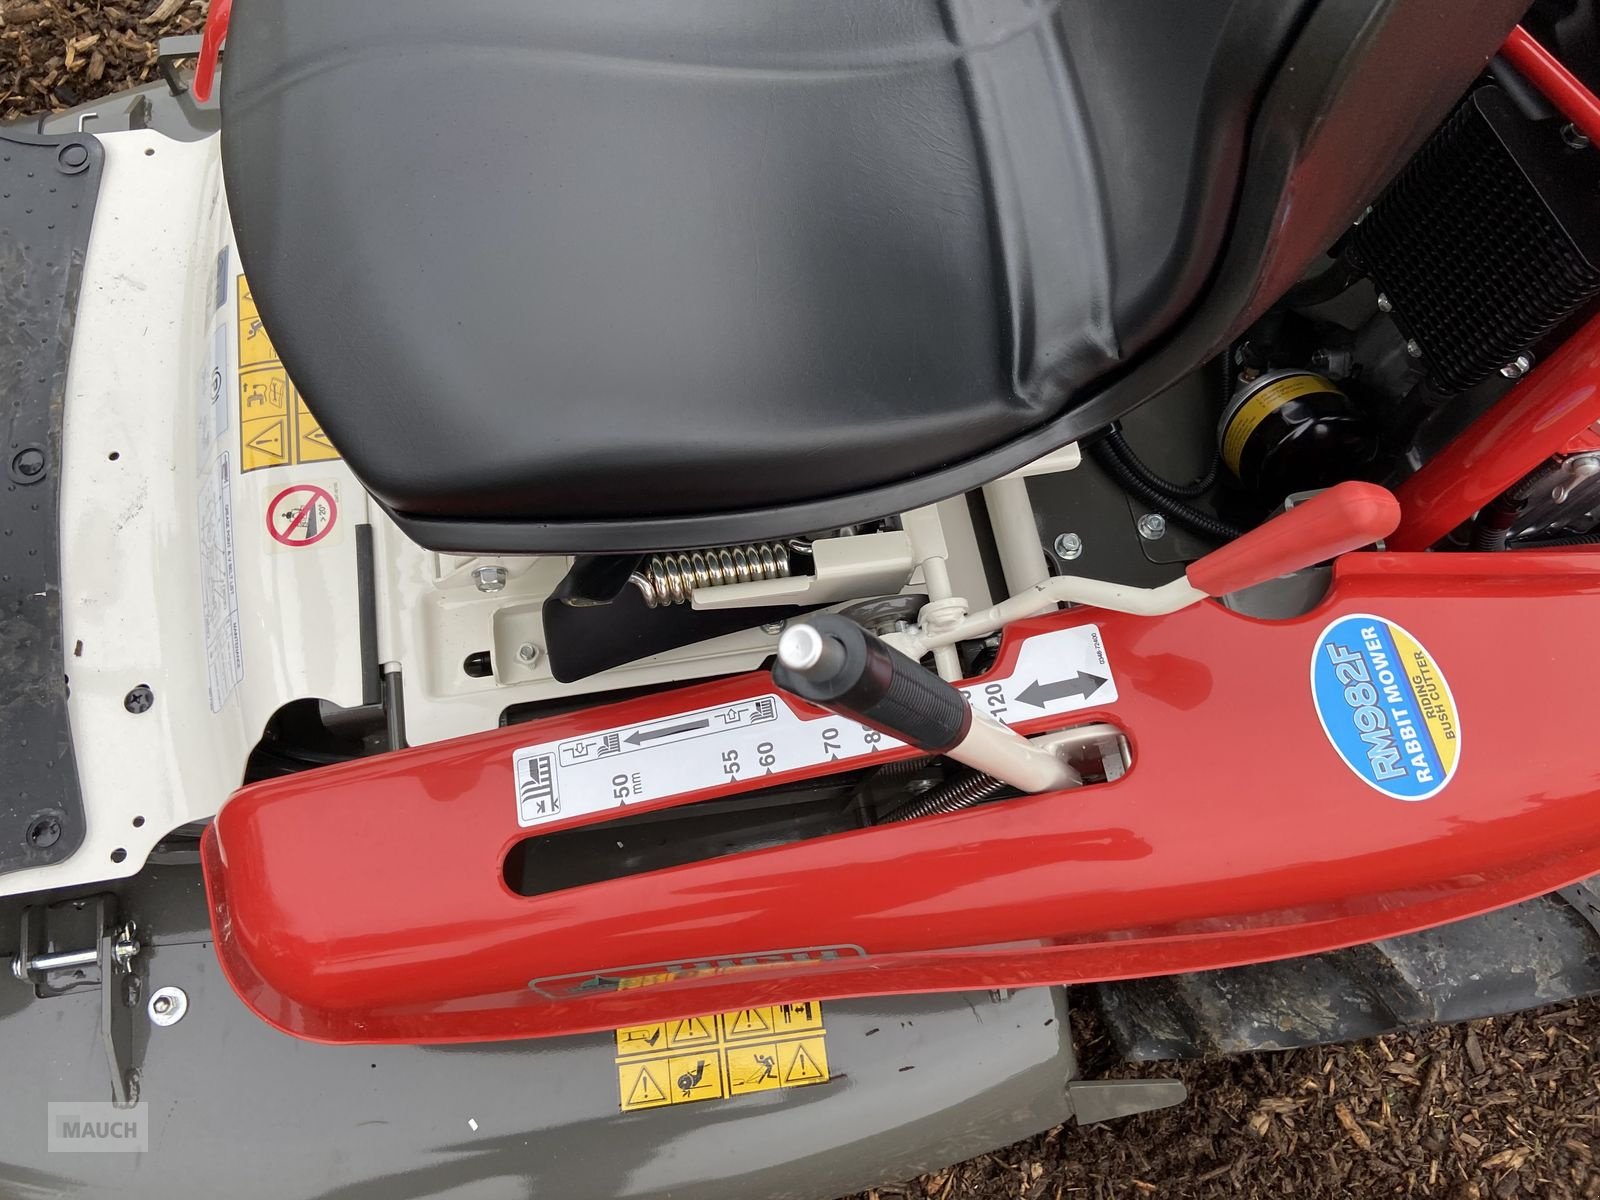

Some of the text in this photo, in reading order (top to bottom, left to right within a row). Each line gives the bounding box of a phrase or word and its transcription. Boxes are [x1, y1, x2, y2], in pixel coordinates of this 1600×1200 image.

[985, 683, 1007, 718] 120
[1361, 626, 1434, 783] RABBIT MOWER
[1412, 676, 1437, 719] RIDING
[1413, 651, 1456, 740] BUSH CUTTER
[1326, 642, 1409, 782] RM982F
[757, 741, 775, 767] 60
[822, 727, 841, 753] 70
[722, 749, 740, 775] 55
[612, 774, 630, 798] 50
[631, 772, 642, 794] mm
